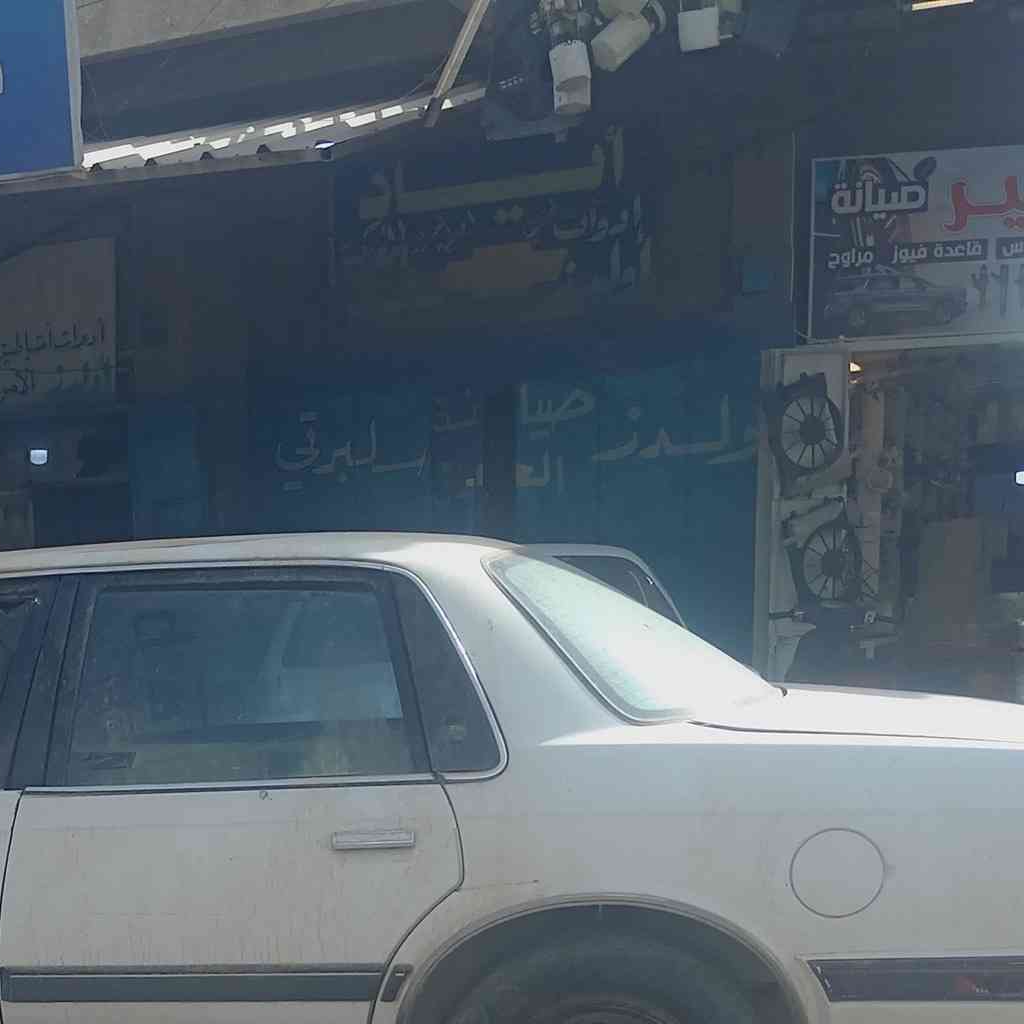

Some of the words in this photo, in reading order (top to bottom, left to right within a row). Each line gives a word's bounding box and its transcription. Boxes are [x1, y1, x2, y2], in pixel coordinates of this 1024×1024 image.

[831, 181, 927, 221] صيانة
[828, 247, 874, 270] مراوح
[933, 239, 983, 259] قاعدة
